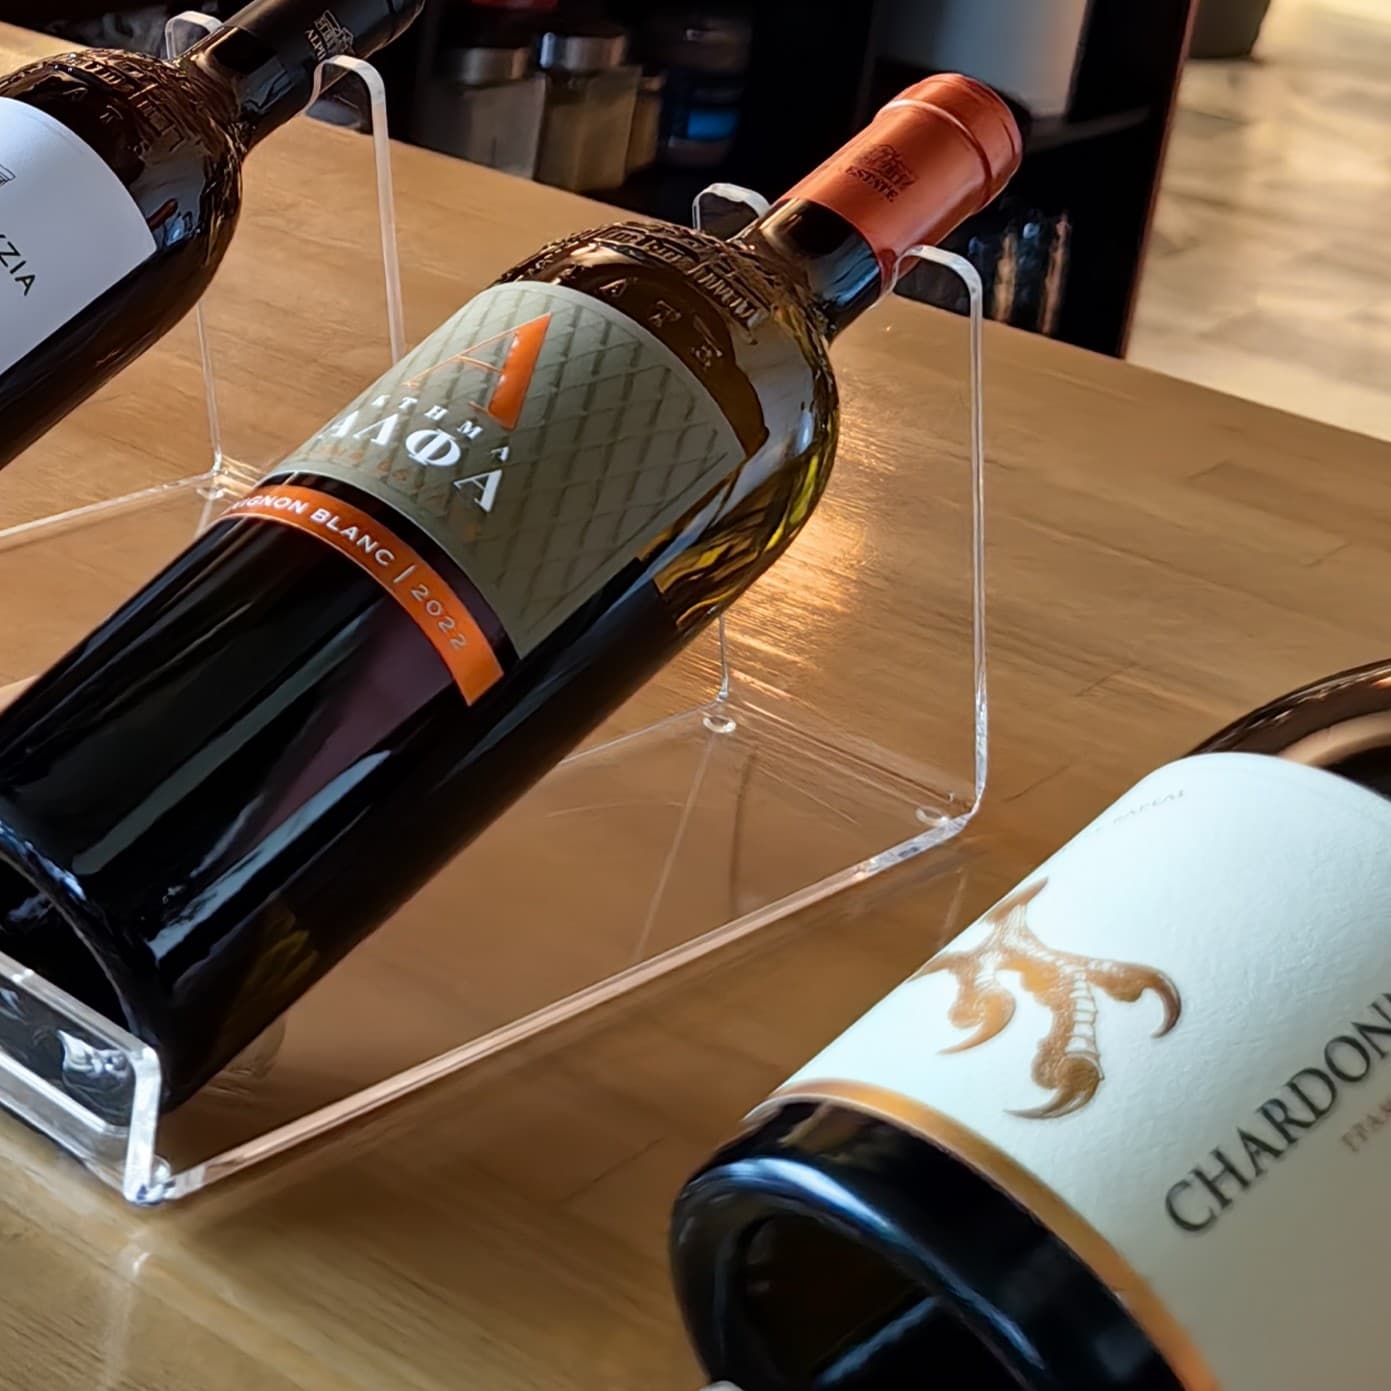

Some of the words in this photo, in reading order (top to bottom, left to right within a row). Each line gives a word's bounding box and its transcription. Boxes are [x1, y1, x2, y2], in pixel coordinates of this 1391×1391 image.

[845, 165, 899, 202] ESTATE
[319, 410, 503, 513] ΑΛΦΑ
[370, 394, 509, 462] ΚΤΗΜΑ
[310, 509, 396, 566] BLANC
[411, 584, 468, 650] 2022
[1165, 993, 1391, 1232] CHARDON
